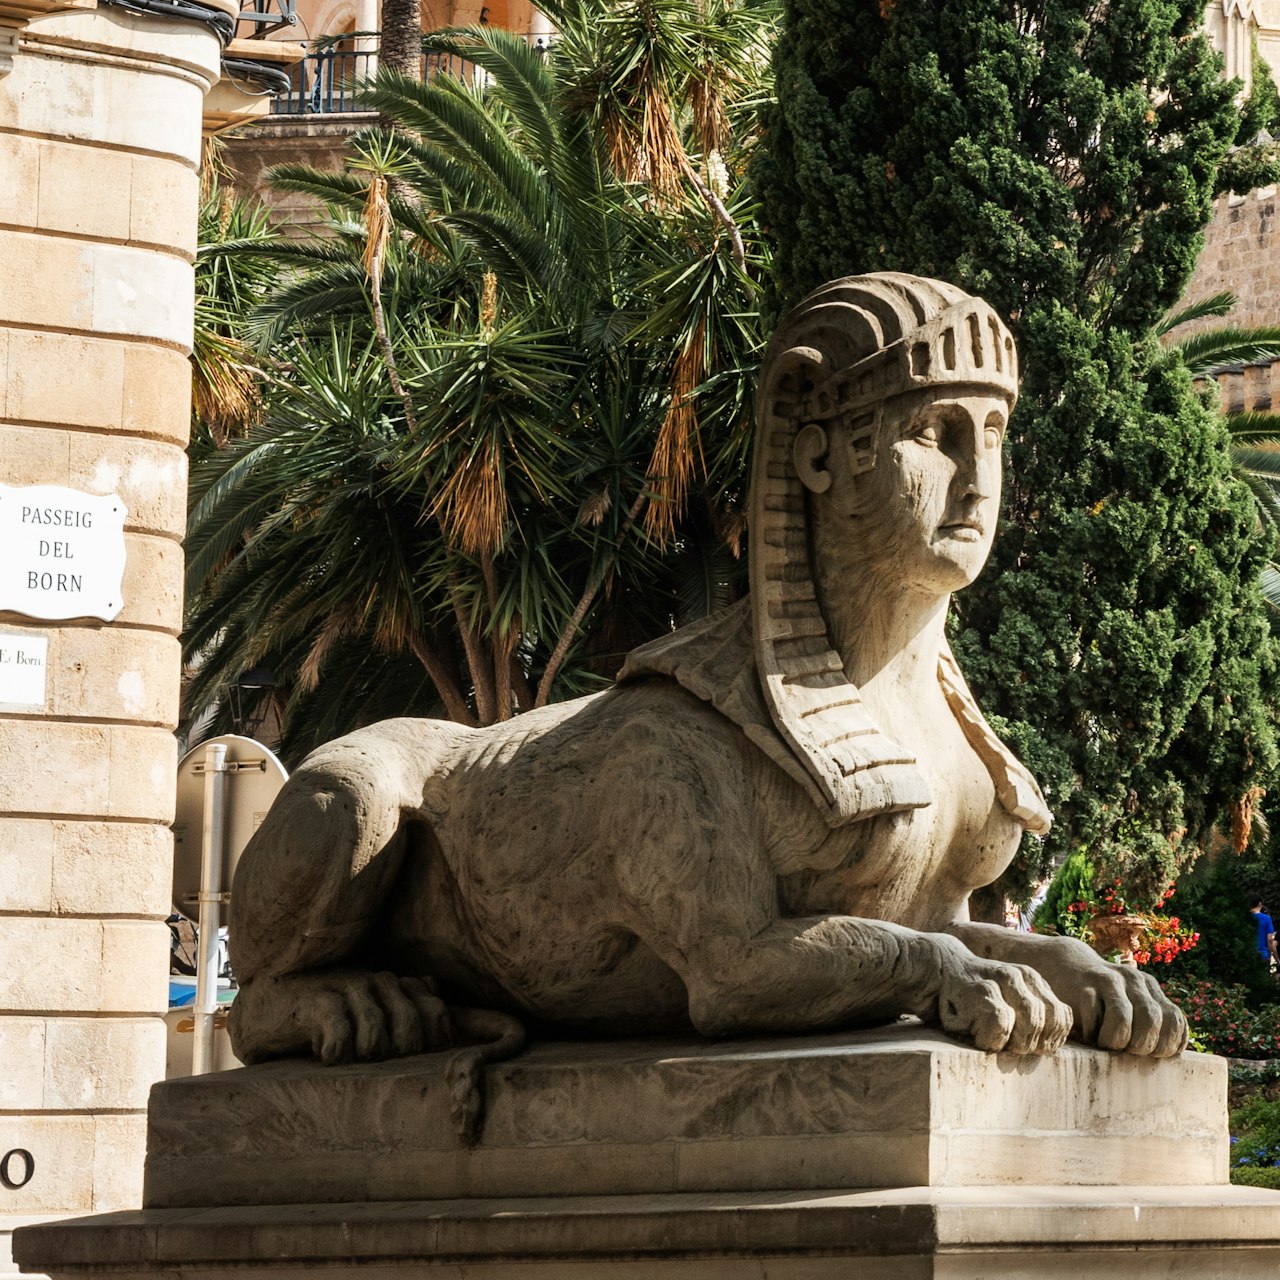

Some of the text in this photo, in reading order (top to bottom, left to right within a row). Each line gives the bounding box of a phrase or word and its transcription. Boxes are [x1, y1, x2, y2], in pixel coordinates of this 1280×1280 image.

[22, 506, 92, 528] PASSEIG
[39, 540, 74, 559] DEL
[28, 571, 82, 592] BORN
